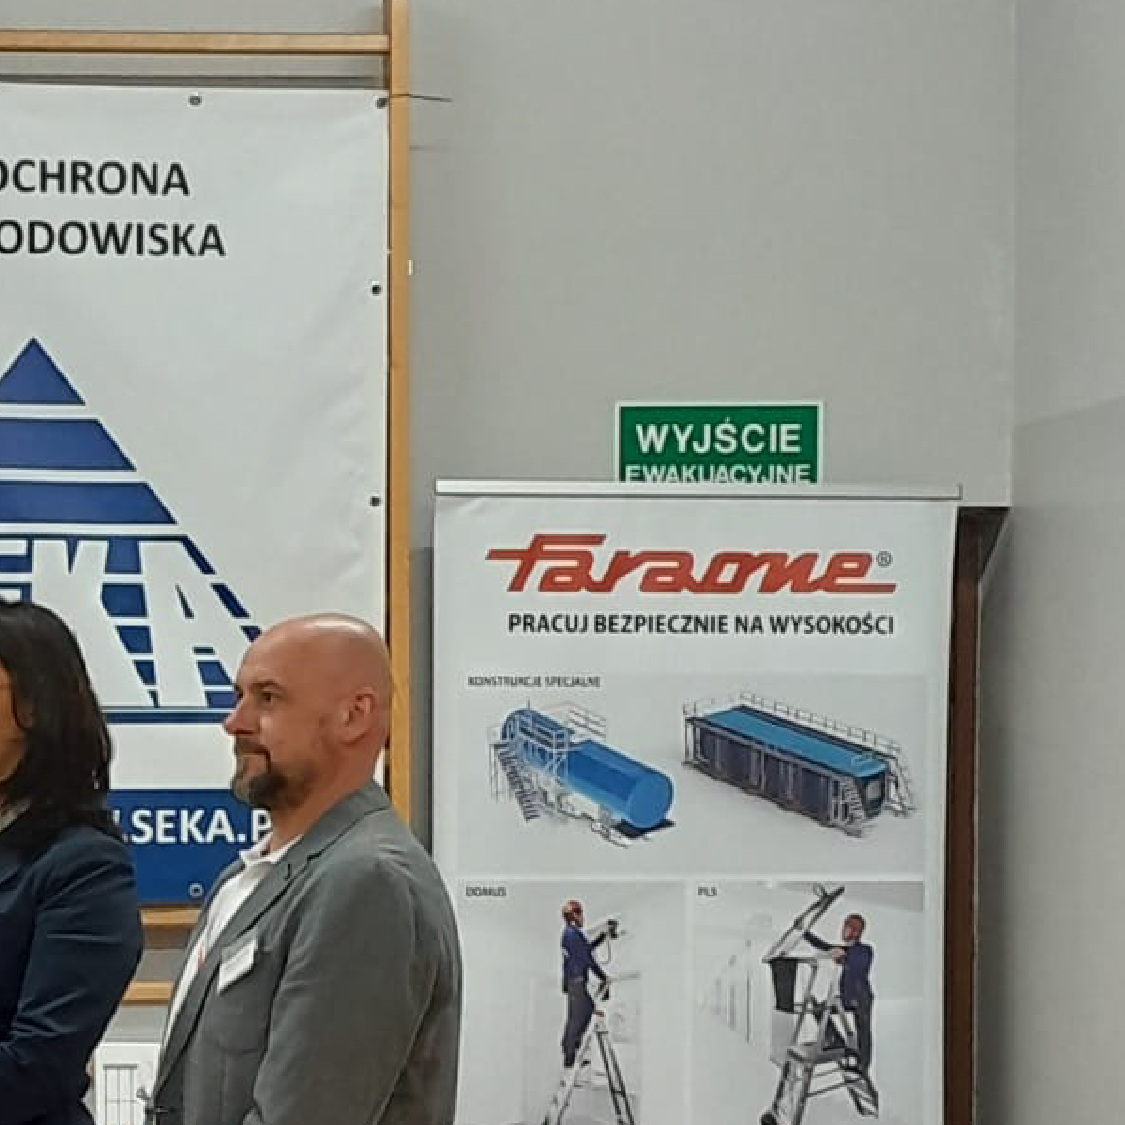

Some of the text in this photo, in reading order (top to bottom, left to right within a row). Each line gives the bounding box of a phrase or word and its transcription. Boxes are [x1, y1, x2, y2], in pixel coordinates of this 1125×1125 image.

[635, 417, 803, 454] WYJŚCIE
[625, 464, 811, 485] EWAKUACYJNE
[508, 611, 894, 636] PRACUJ BEZPIECZNIE NA WYSOKOŚCI
[468, 676, 600, 688] KONSTRUKCJE SPECJALNE
